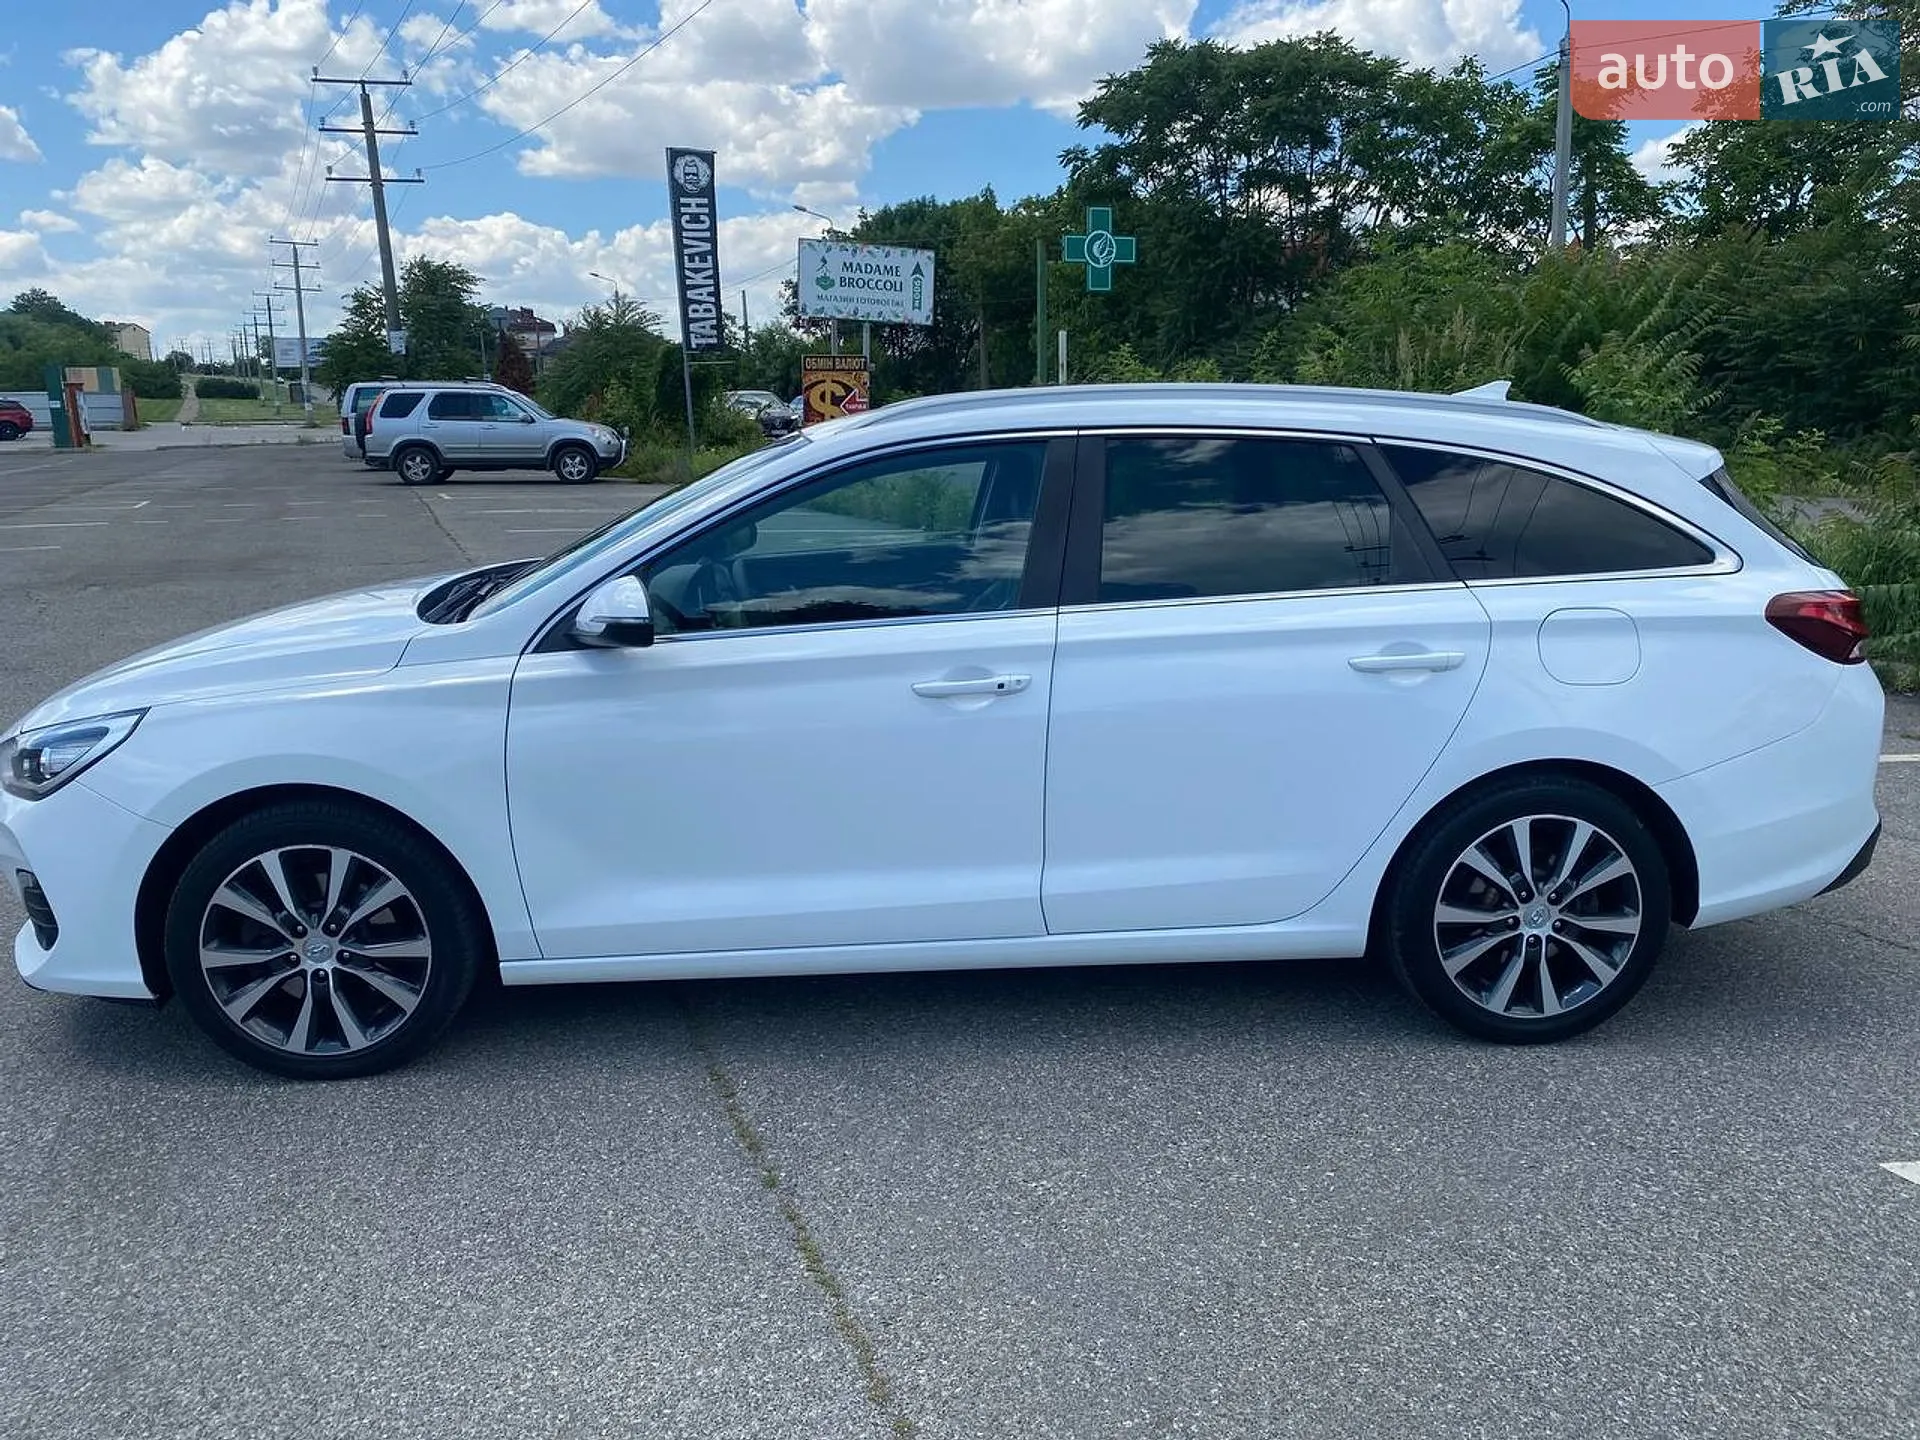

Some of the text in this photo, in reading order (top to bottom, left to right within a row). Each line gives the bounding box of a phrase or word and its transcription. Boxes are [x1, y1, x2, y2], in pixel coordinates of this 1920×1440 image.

[680, 196, 718, 349] TABAKEVICH
[841, 261, 901, 277] MADAME
[839, 276, 903, 293] BROCCOLI
[805, 357, 865, 370] ОБМІН ВАЛЮТ
